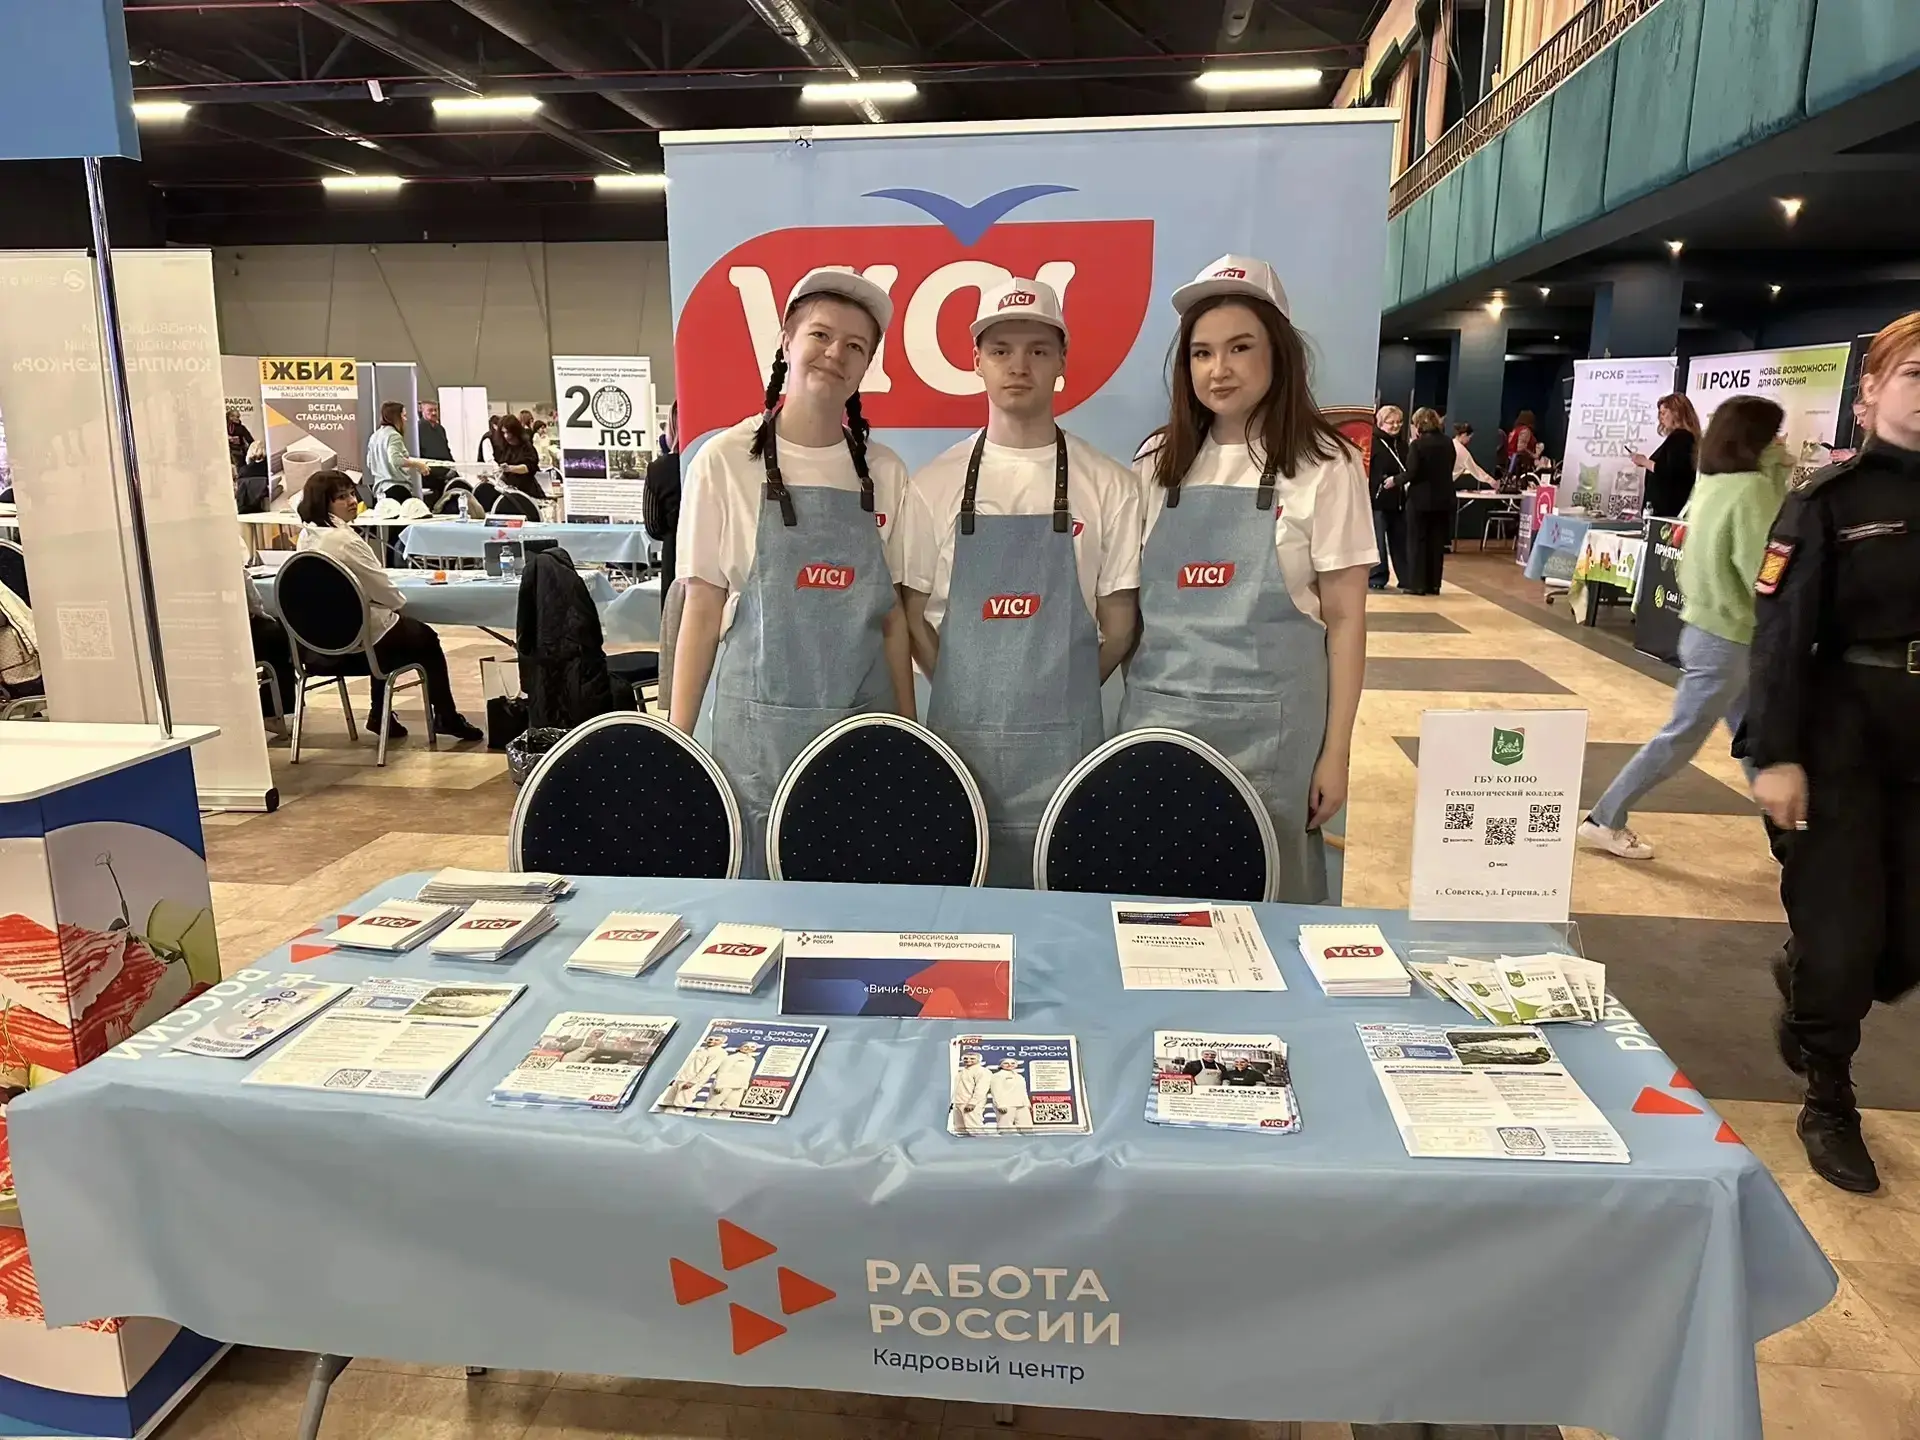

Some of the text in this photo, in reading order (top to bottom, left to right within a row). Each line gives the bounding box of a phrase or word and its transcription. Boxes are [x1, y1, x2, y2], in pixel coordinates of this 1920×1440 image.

[269, 361, 354, 380] ЖБИ 2
[1594, 370, 1625, 380] РСХБ
[1759, 363, 1837, 376] НОВЫЕ ВОЗМОЖНОСТИ
[1710, 370, 1751, 390] РСХБ
[1757, 376, 1807, 388] ДЛЯ ОБУЧЕНИЯ
[1599, 393, 1641, 408] ТЕБЕ
[295, 413, 356, 421] СТАБИЛЬНАЯ
[1581, 409, 1651, 424] РЕШАТЬ
[308, 423, 344, 431] РАБОТА
[1593, 424, 1640, 439] КЕМ
[598, 429, 646, 447] лет
[1474, 775, 1538, 784] ГБУ КО ПОО
[1444, 789, 1565, 798] Технологический колледж
[1444, 888, 1484, 897] Советск,
[1485, 889, 1499, 898] ул.
[1501, 888, 1540, 898] Герцена,
[1552, 888, 1557, 896] 5
[863, 984, 934, 995] «Вичи-Русь»
[713, 1027, 814, 1038] Работа рядом
[764, 1035, 811, 1044] домом
[1180, 1040, 1272, 1049] комфортом!
[1020, 1045, 1068, 1053] рядом
[865, 1259, 1110, 1302] РАБОТА
[869, 1303, 1121, 1346] РОССИИ
[873, 1348, 1086, 1385] Кадровый центр
